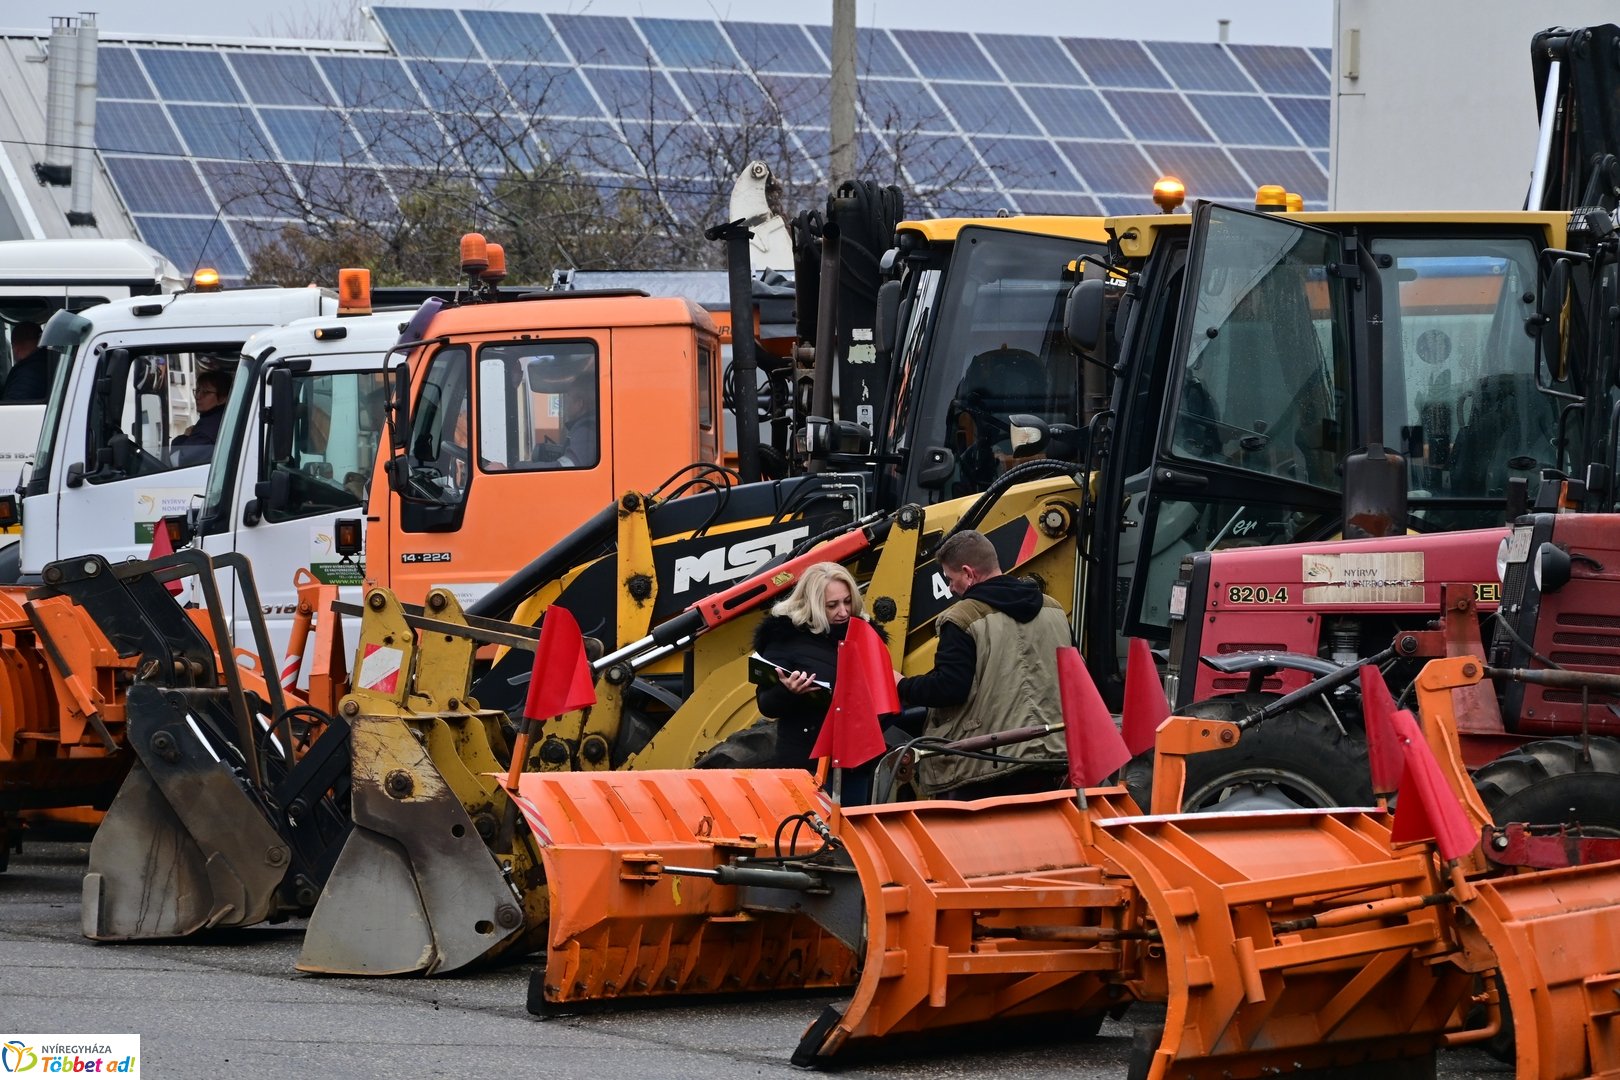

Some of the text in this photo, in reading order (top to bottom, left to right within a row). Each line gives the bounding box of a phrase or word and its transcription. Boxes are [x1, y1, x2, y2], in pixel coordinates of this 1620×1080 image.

[673, 525, 810, 595] MST
[1343, 568, 1378, 577] NYÍRVV
[1229, 586, 1288, 604] 820.4
